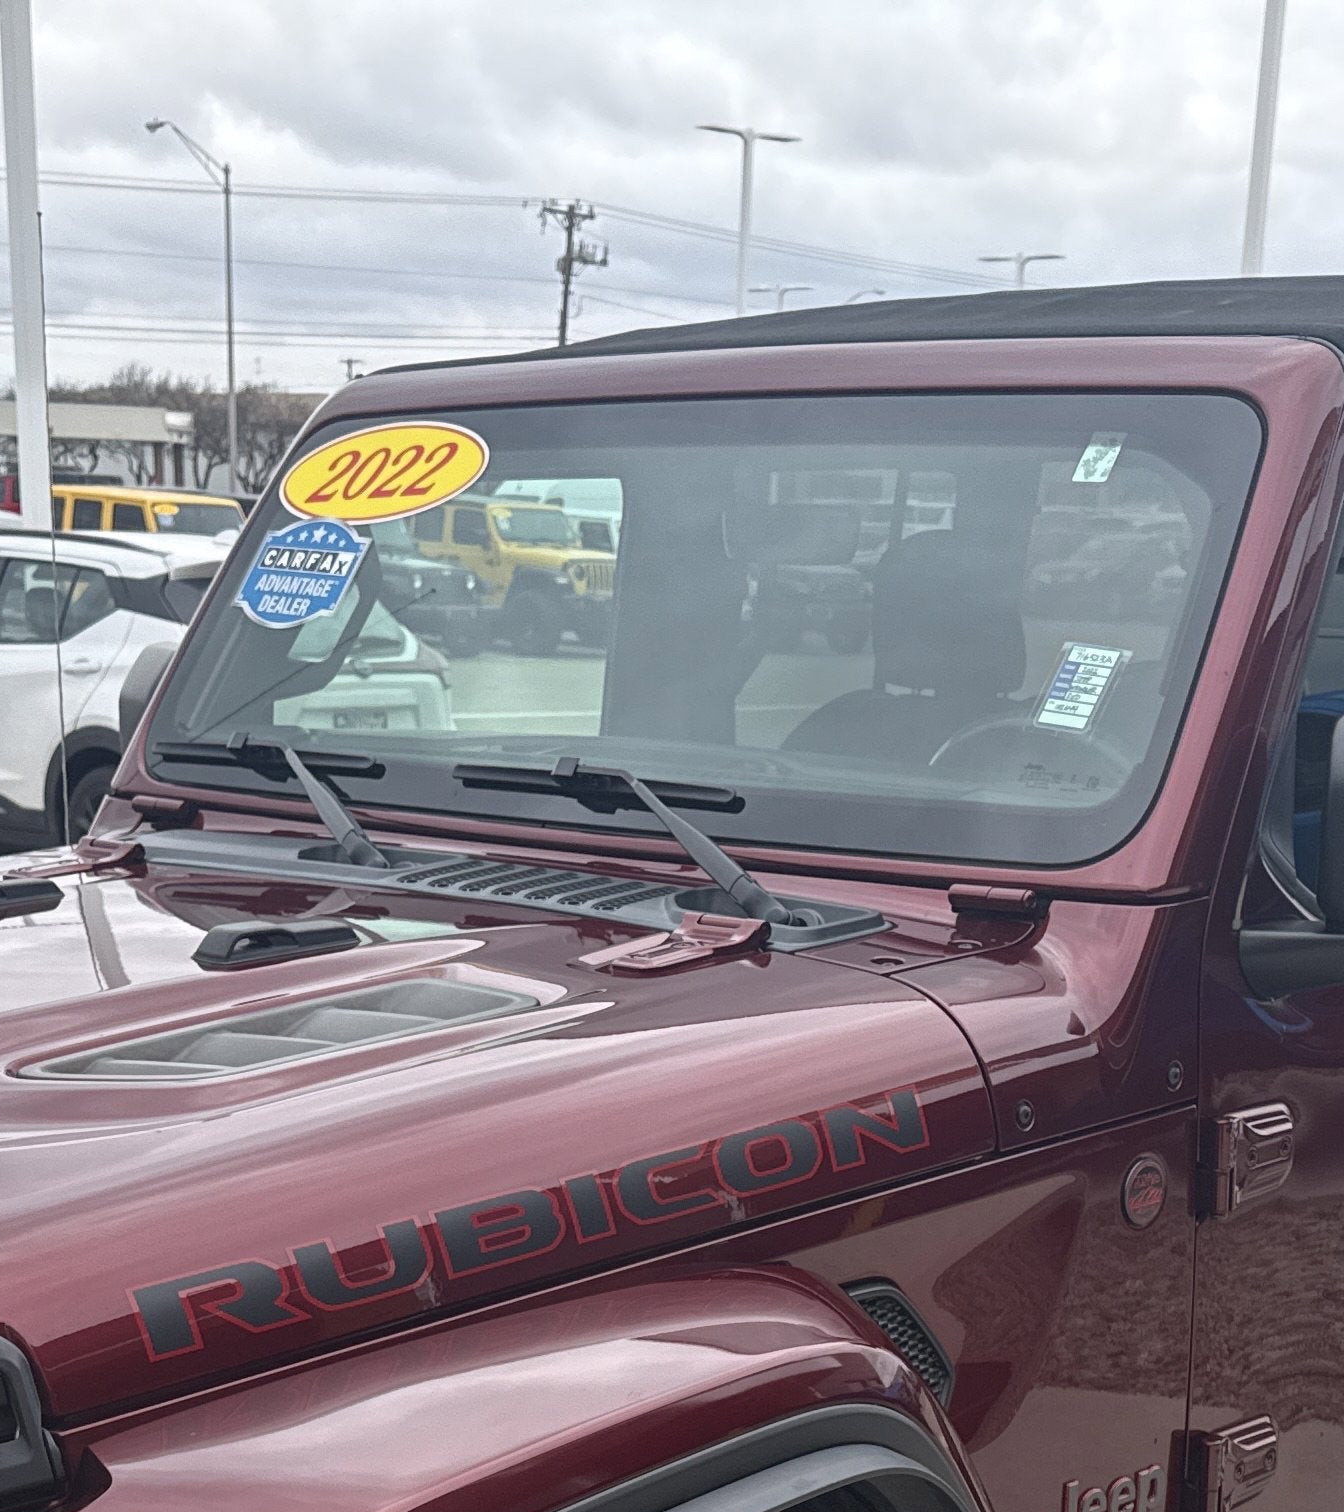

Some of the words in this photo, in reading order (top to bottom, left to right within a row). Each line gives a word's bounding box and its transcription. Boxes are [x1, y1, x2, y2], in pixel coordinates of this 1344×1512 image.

[304, 442, 459, 504] 2022
[262, 547, 350, 575] CARFAX
[255, 574, 334, 598] ADVANTAGE
[258, 595, 311, 616] DEALER
[125, 1083, 931, 1362] RUBICON
